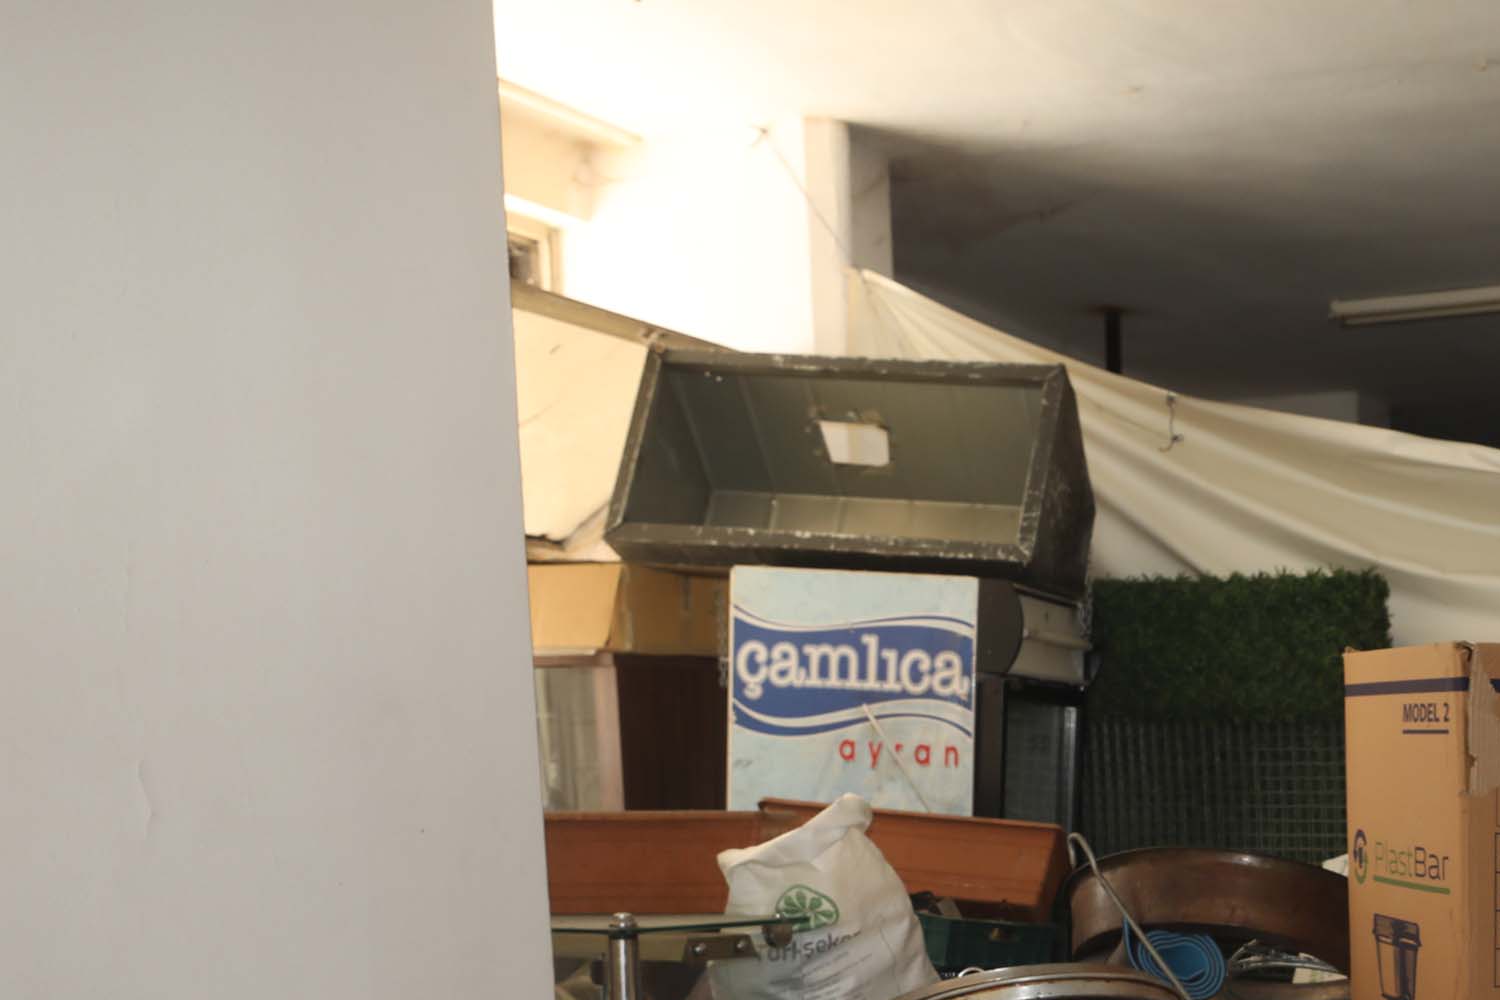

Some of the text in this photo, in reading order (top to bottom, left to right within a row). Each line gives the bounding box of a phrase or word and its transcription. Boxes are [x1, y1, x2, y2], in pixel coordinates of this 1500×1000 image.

[737, 635, 970, 700] çamlıca
[1402, 702, 1451, 722] MODEL 2
[838, 738, 960, 769] ayran
[1374, 841, 1450, 881] PlastBar
